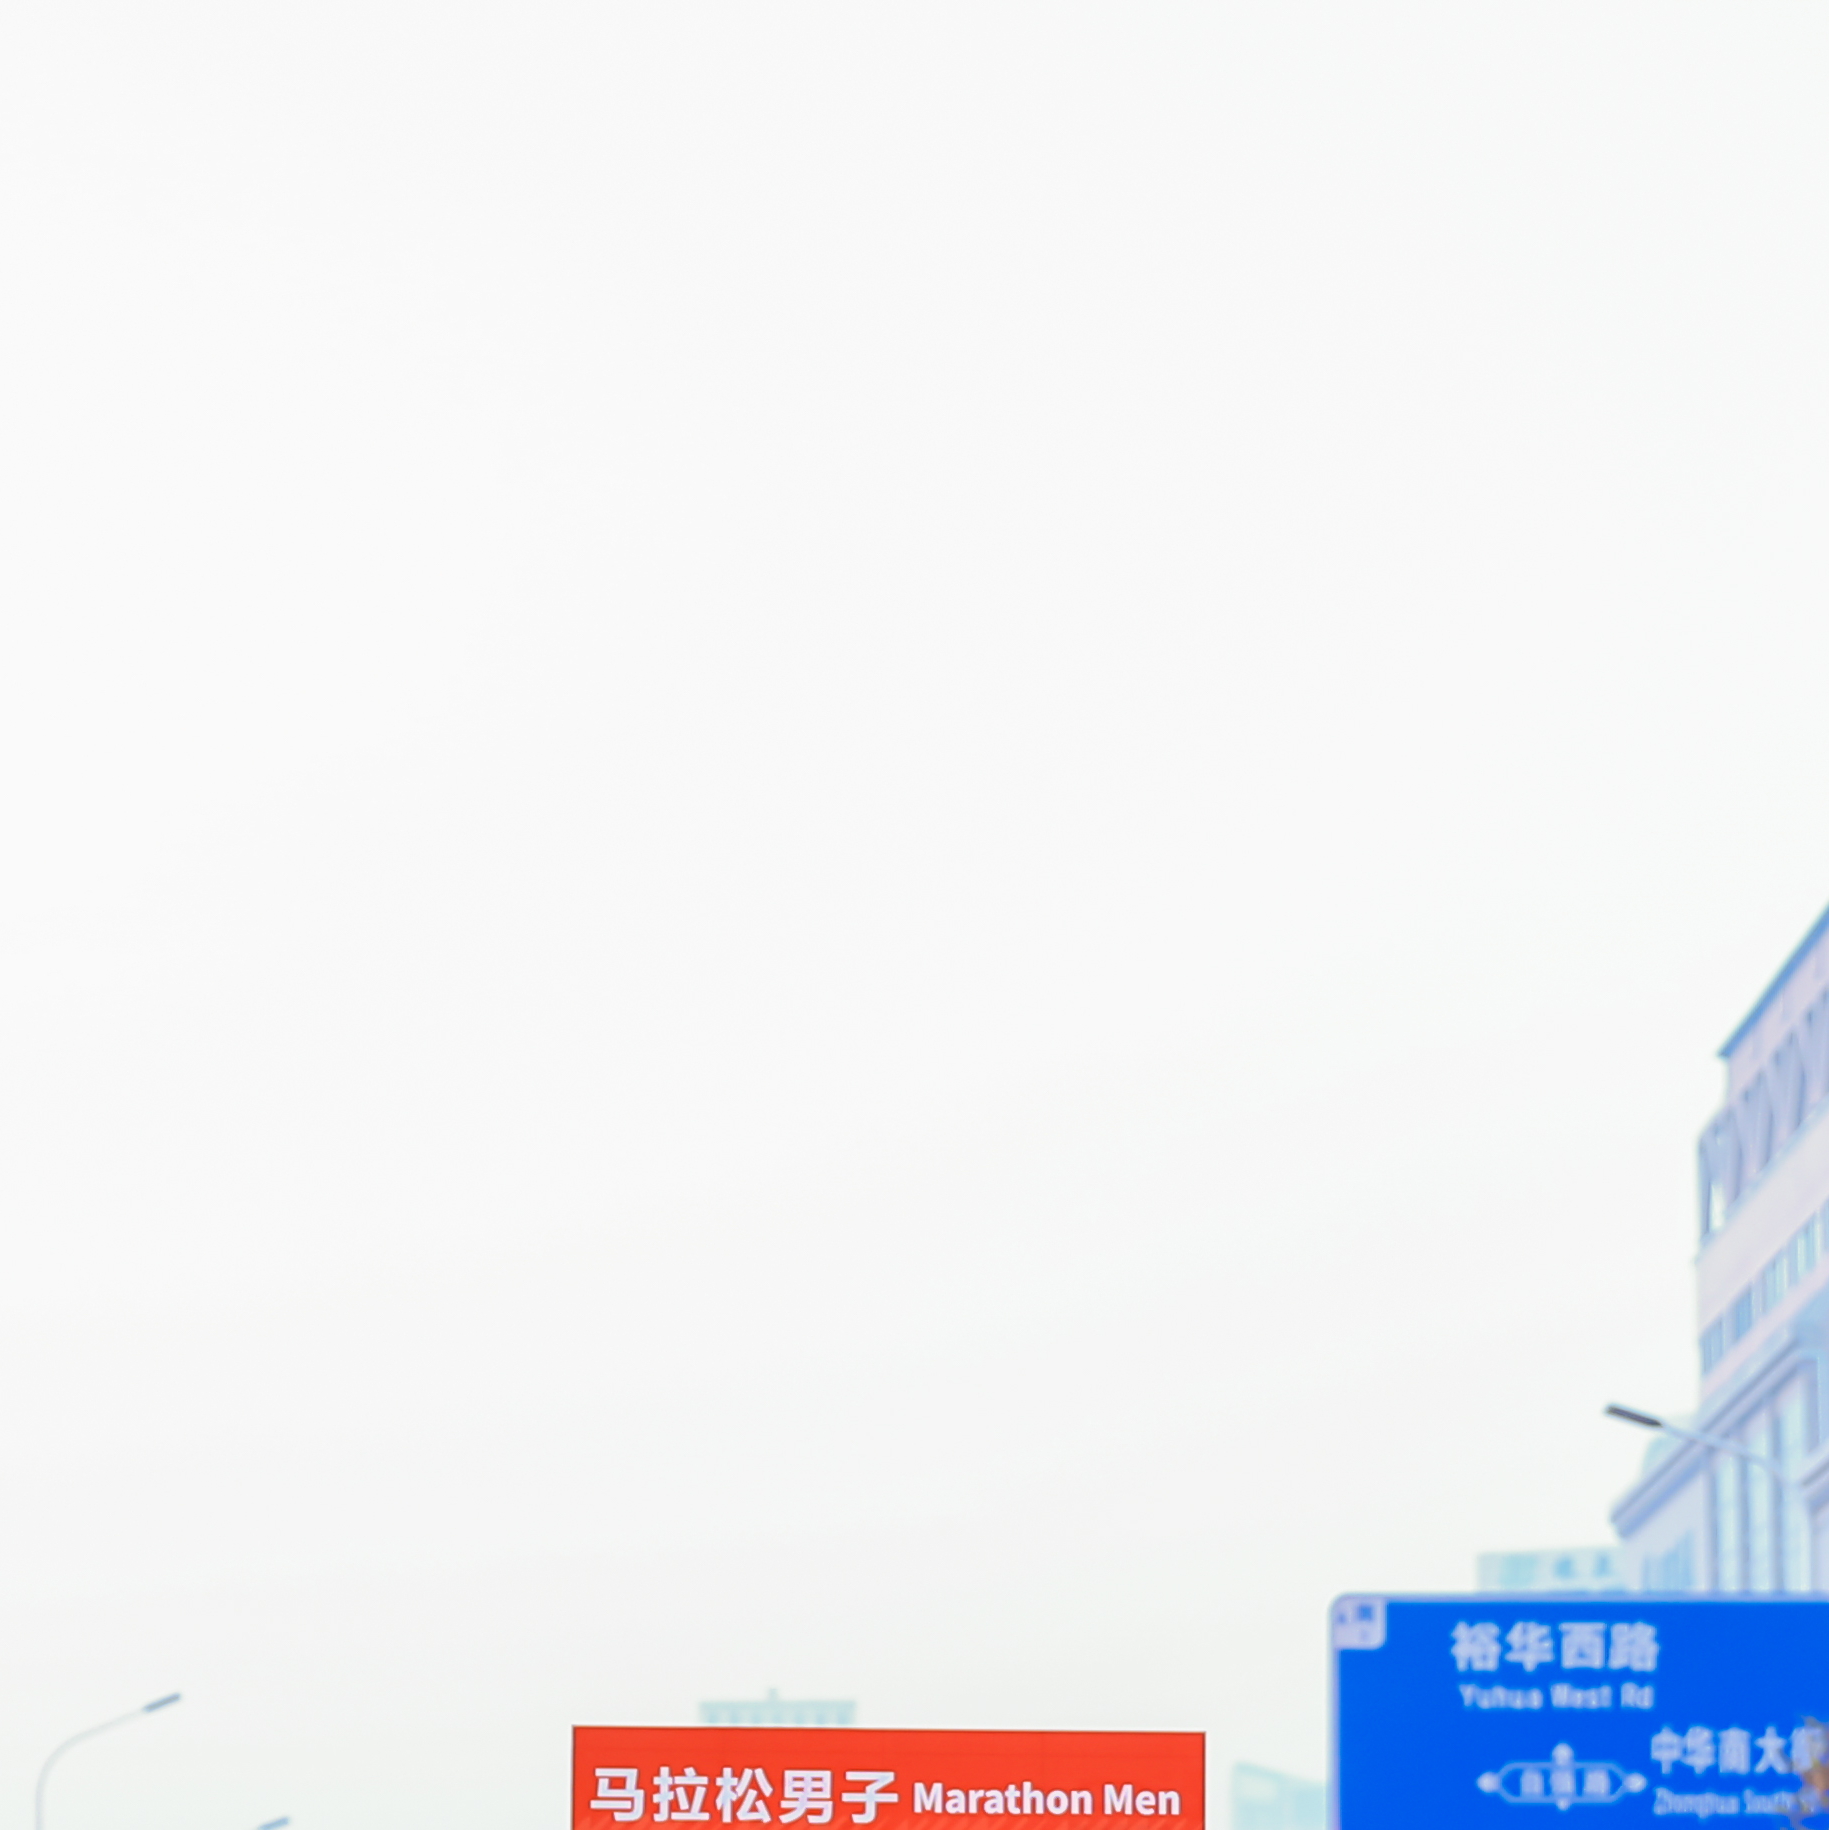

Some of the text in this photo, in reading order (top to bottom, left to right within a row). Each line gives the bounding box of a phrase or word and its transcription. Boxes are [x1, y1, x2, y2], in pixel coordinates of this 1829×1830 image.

[1451, 1621, 1660, 1672] 裕华西路
[1460, 1684, 1654, 1709] Yuhua West Rd
[590, 1767, 1180, 1824] 马拉松男子 Marathon Men
